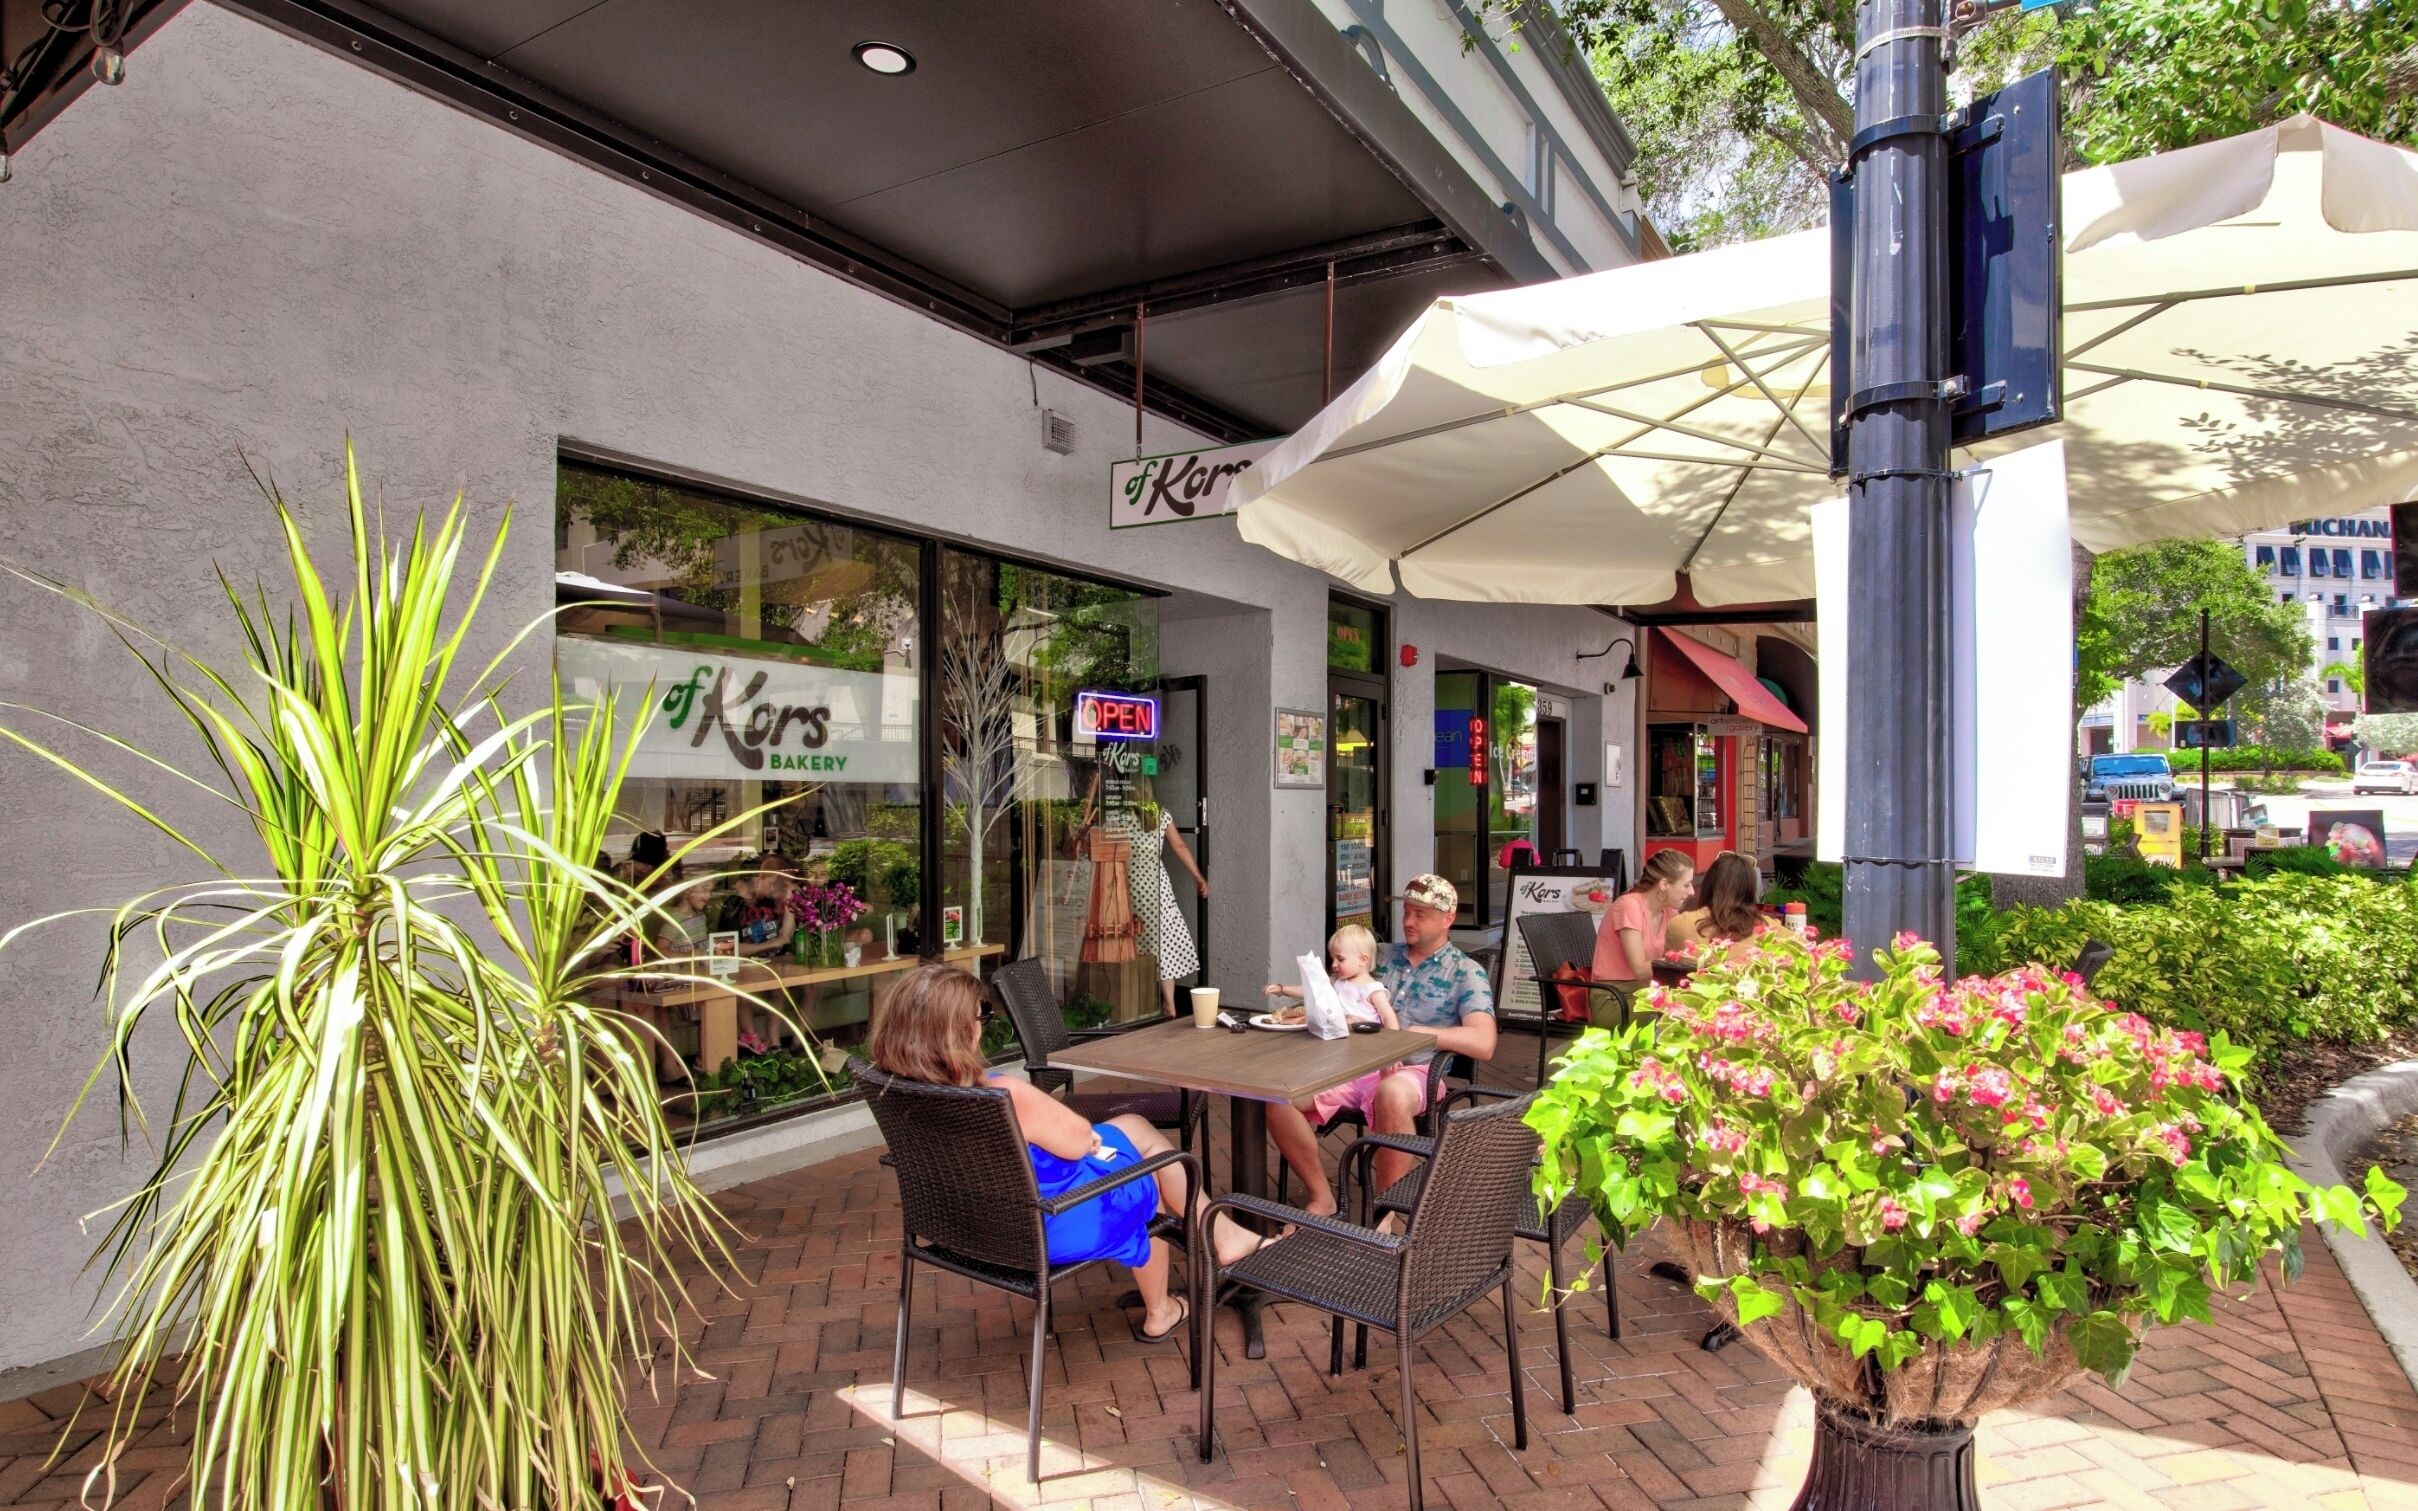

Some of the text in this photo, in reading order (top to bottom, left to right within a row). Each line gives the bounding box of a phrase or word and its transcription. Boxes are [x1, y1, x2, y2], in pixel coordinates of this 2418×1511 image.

[1125, 460, 1158, 506] of
[662, 665, 832, 771] of Kors
[1082, 697, 1151, 733] OPEN
[771, 754, 848, 771] BAKERY
